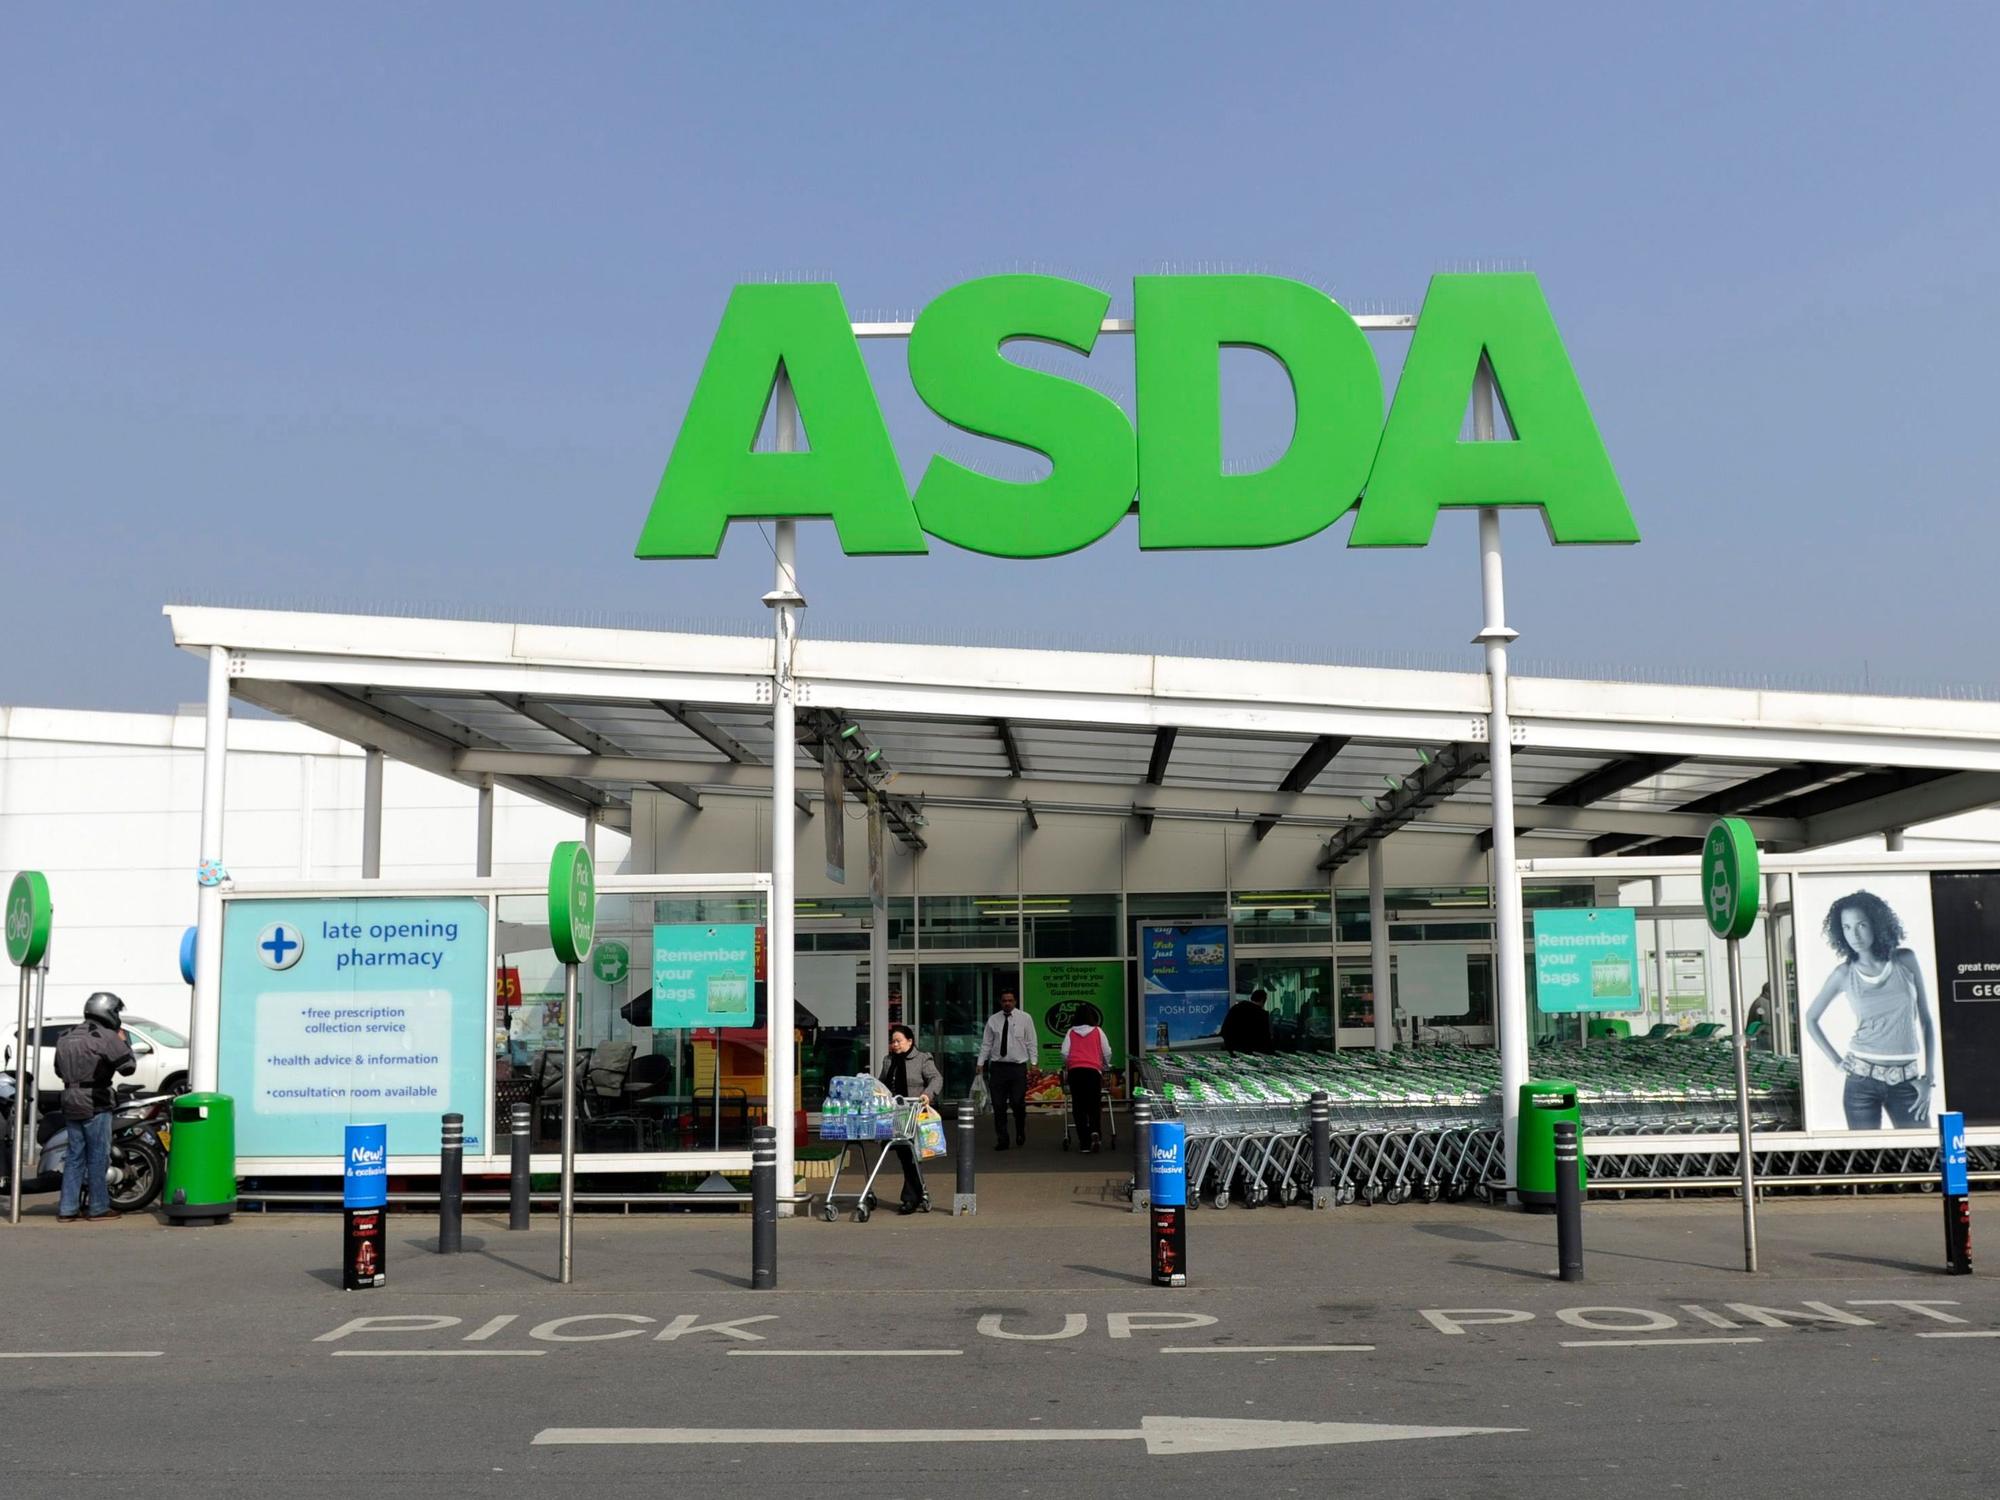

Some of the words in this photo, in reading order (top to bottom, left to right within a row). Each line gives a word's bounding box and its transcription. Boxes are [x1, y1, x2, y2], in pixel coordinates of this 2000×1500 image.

[633, 271, 1641, 560] ASDA
[1712, 836, 1725, 855] Taxi
[577, 863, 588, 886] Pick
[579, 891, 587, 912] up
[322, 921, 362, 939] late
[370, 919, 458, 942] opening
[575, 917, 591, 940] Point
[1538, 932, 1629, 947] Remember
[337, 948, 443, 971] pharmacy
[656, 948, 747, 962] Remember
[1539, 953, 1576, 967] your
[656, 969, 694, 982] your
[1066, 966, 1097, 974] cheaper
[1957, 962, 1982, 974] great
[1540, 970, 1580, 986] bags
[656, 987, 695, 1002] bags
[334, 1007, 405, 1020] prescription
[1159, 1005, 1185, 1015] POSH
[1188, 1004, 1215, 1014] DROP
[305, 1022, 362, 1034] collection
[366, 1022, 406, 1033] service
[273, 1055, 310, 1066] health
[314, 1055, 352, 1065] advice
[355, 1055, 364, 1065] &
[368, 1054, 438, 1065] information
[272, 1087, 346, 1098] consultation
[350, 1088, 381, 1098] room
[384, 1086, 438, 1097] available
[352, 1145, 383, 1163] New!
[1151, 1144, 1177, 1160] New!
[311, 1313, 779, 1344] PICK
[976, 1312, 1220, 1342] UP
[1418, 1299, 1969, 1335] POINT
